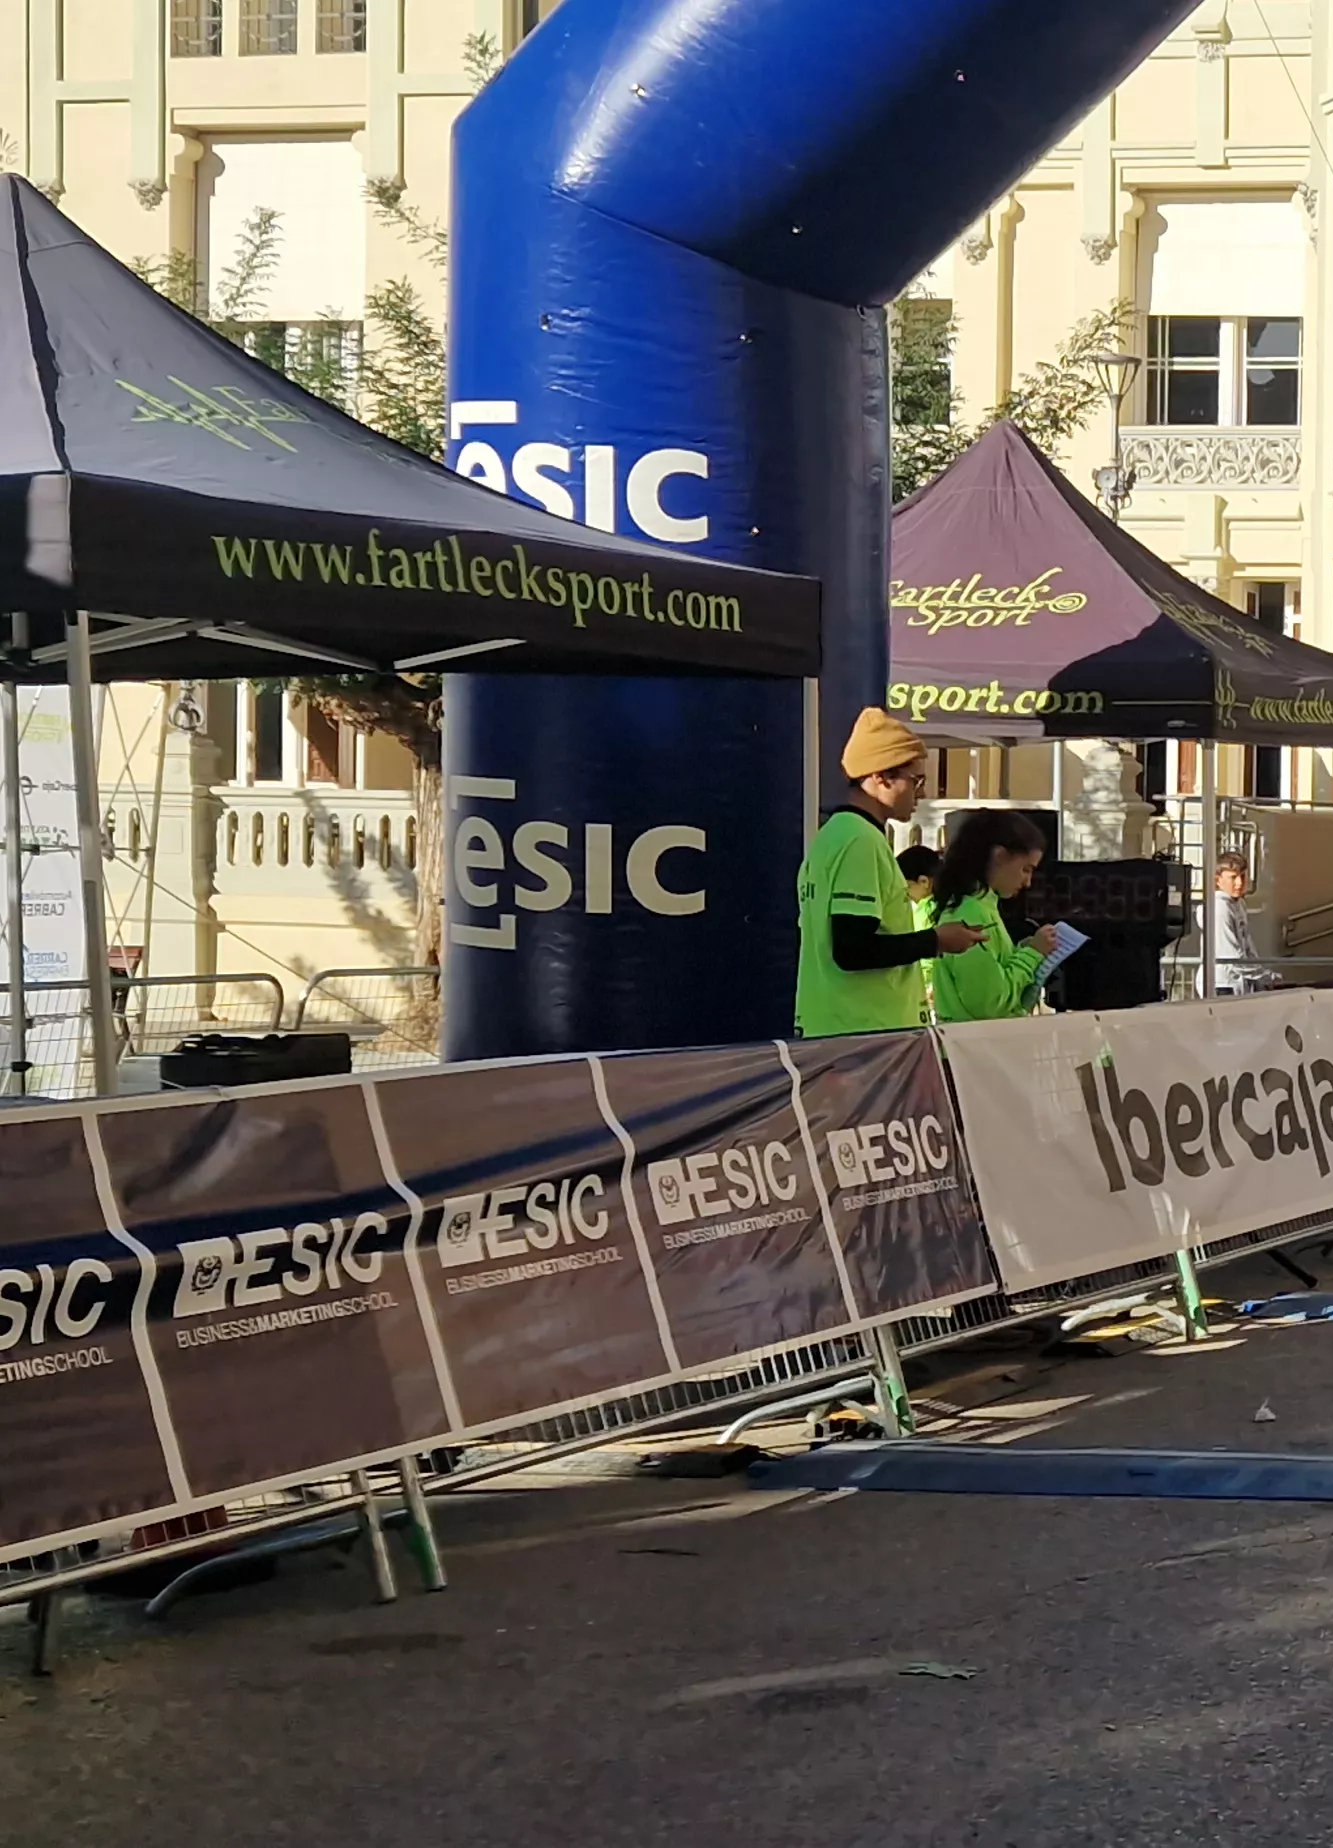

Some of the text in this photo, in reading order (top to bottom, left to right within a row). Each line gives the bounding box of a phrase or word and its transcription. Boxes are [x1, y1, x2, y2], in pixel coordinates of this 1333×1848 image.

[210, 528, 744, 634] www.fartlecksport.com
[907, 597, 1040, 636] Sport
[888, 679, 1104, 722] sport.com
[686, 1140, 797, 1219] ESIC
[857, 1114, 948, 1184] ESIC
[488, 1173, 608, 1260] ESIC
[233, 1212, 387, 1308] ESIC
[0, 1258, 113, 1352] SIC
[0, 1346, 114, 1384] ETINGSCHOOL
